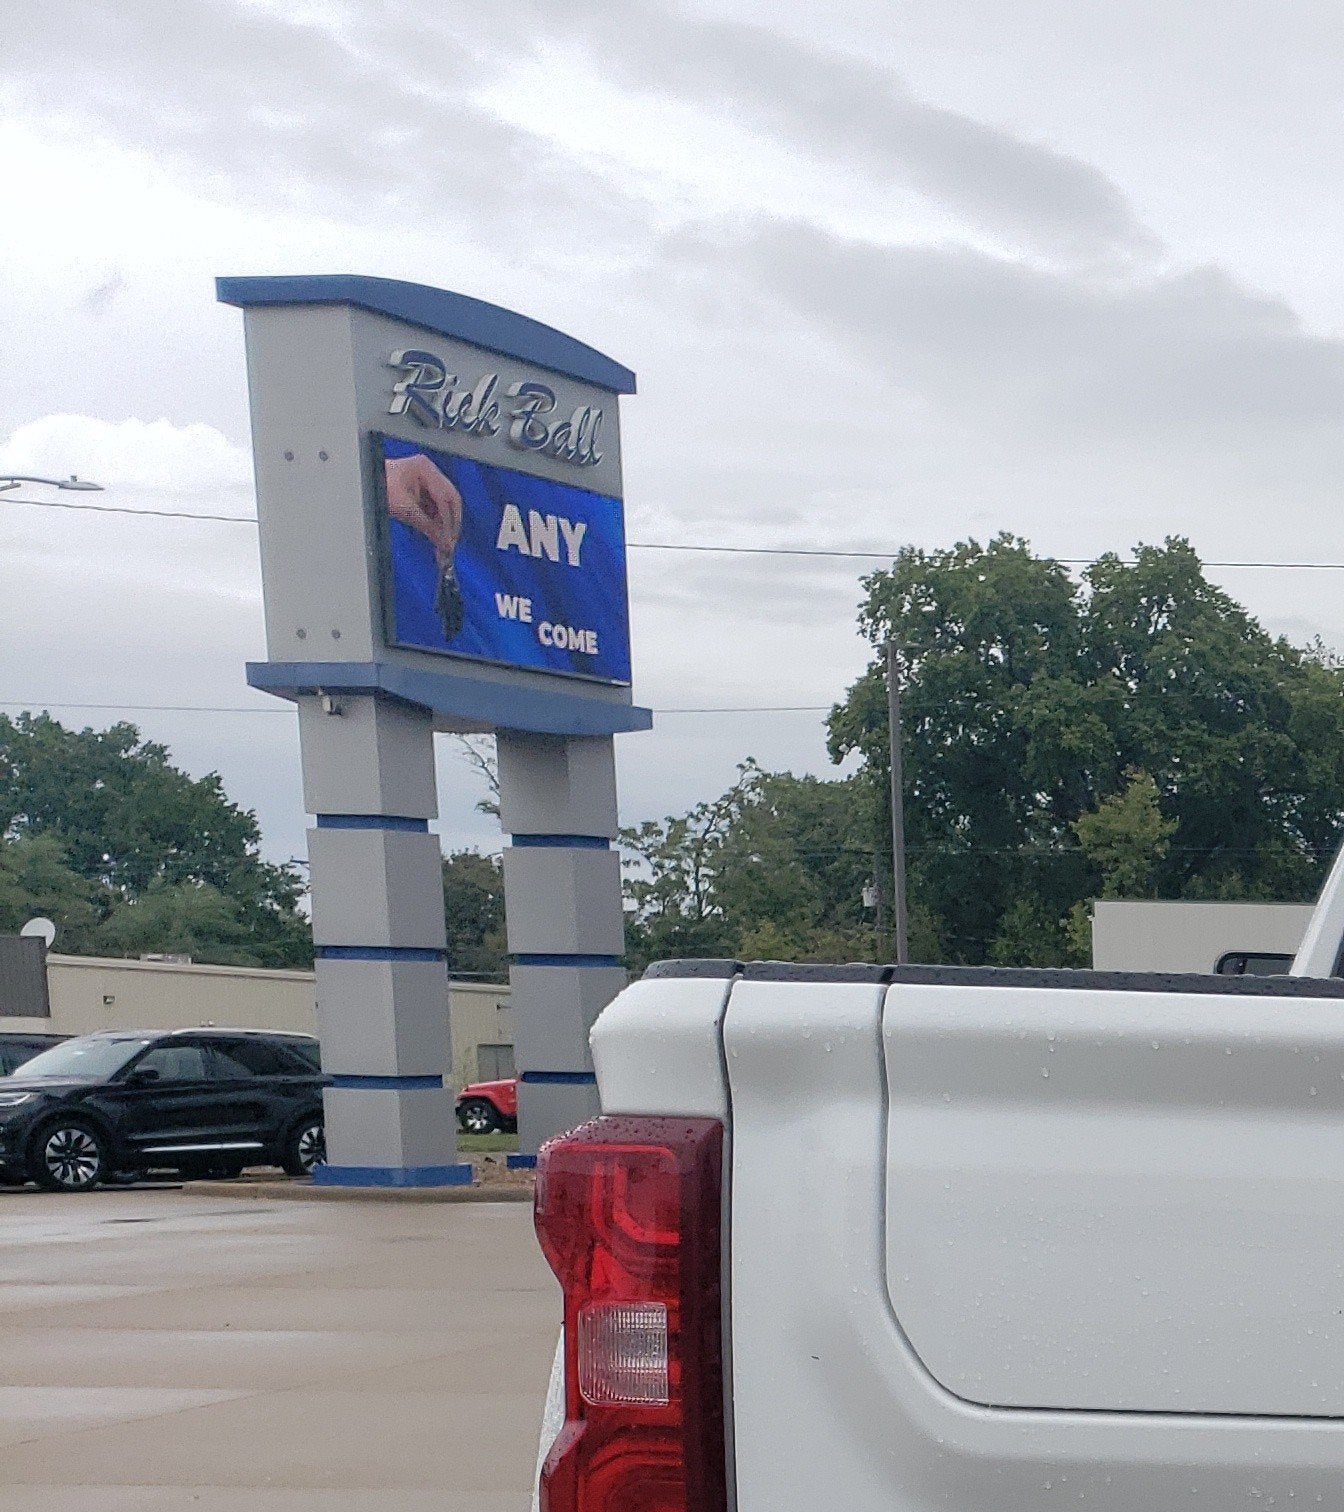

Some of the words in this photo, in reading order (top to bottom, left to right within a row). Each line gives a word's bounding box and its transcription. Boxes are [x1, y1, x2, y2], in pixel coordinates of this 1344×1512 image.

[386, 349, 503, 437] Rick
[506, 381, 603, 467] Ball
[496, 503, 588, 567] ANY
[495, 592, 533, 623] WE
[537, 620, 599, 655] COME
